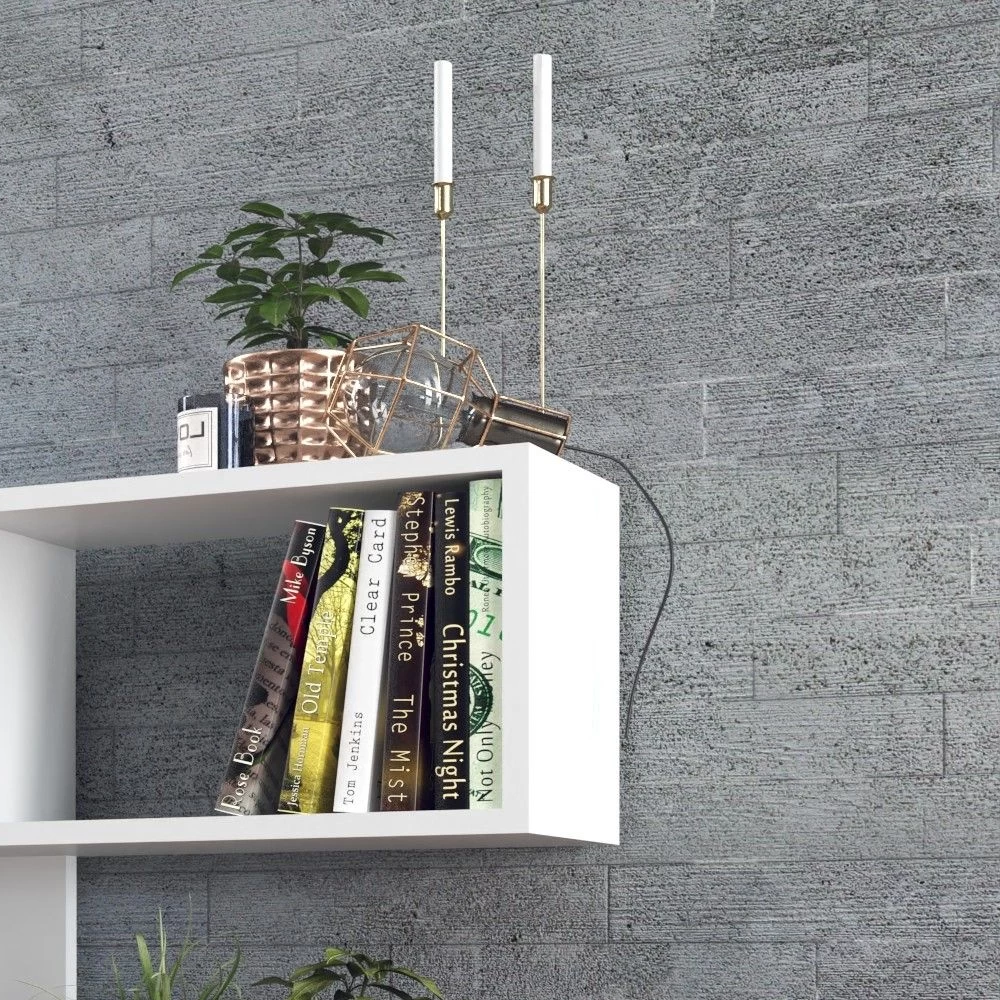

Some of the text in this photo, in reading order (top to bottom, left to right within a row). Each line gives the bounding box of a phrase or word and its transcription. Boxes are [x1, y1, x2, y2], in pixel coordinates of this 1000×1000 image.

[290, 527, 316, 567] Byson
[361, 518, 387, 635] Clear Card
[444, 498, 461, 596] Lewis Rambo
[280, 571, 304, 604] Mike
[308, 611, 336, 675] Temple
[398, 593, 419, 661] Prince
[301, 682, 321, 714] Old
[435, 624, 466, 799] Christmas Night
[221, 727, 262, 809] Rose Book
[343, 712, 363, 806] Tom Jenkins
[388, 695, 414, 802] The Mist
[476, 721, 500, 762] Only
[287, 775, 302, 807] Jessica
[477, 770, 493, 802] Not
